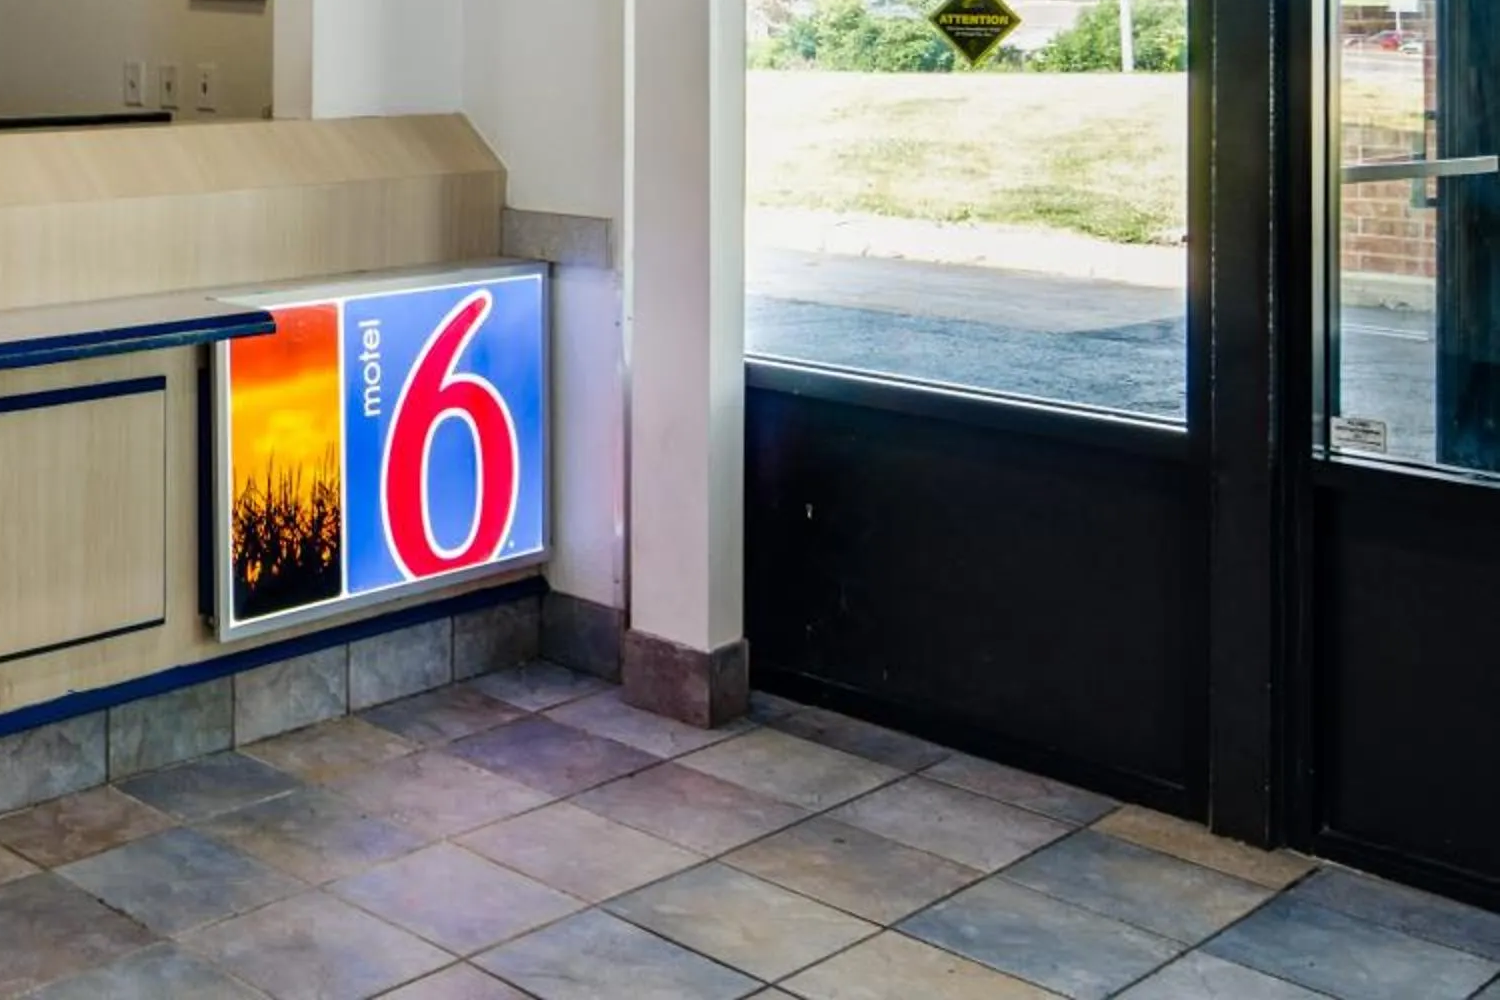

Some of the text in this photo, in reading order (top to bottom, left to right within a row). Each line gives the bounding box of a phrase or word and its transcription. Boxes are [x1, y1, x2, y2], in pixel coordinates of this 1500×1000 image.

[939, 14, 1010, 26] ATTENTION
[358, 318, 383, 418] motel
[380, 288, 520, 582] 6
